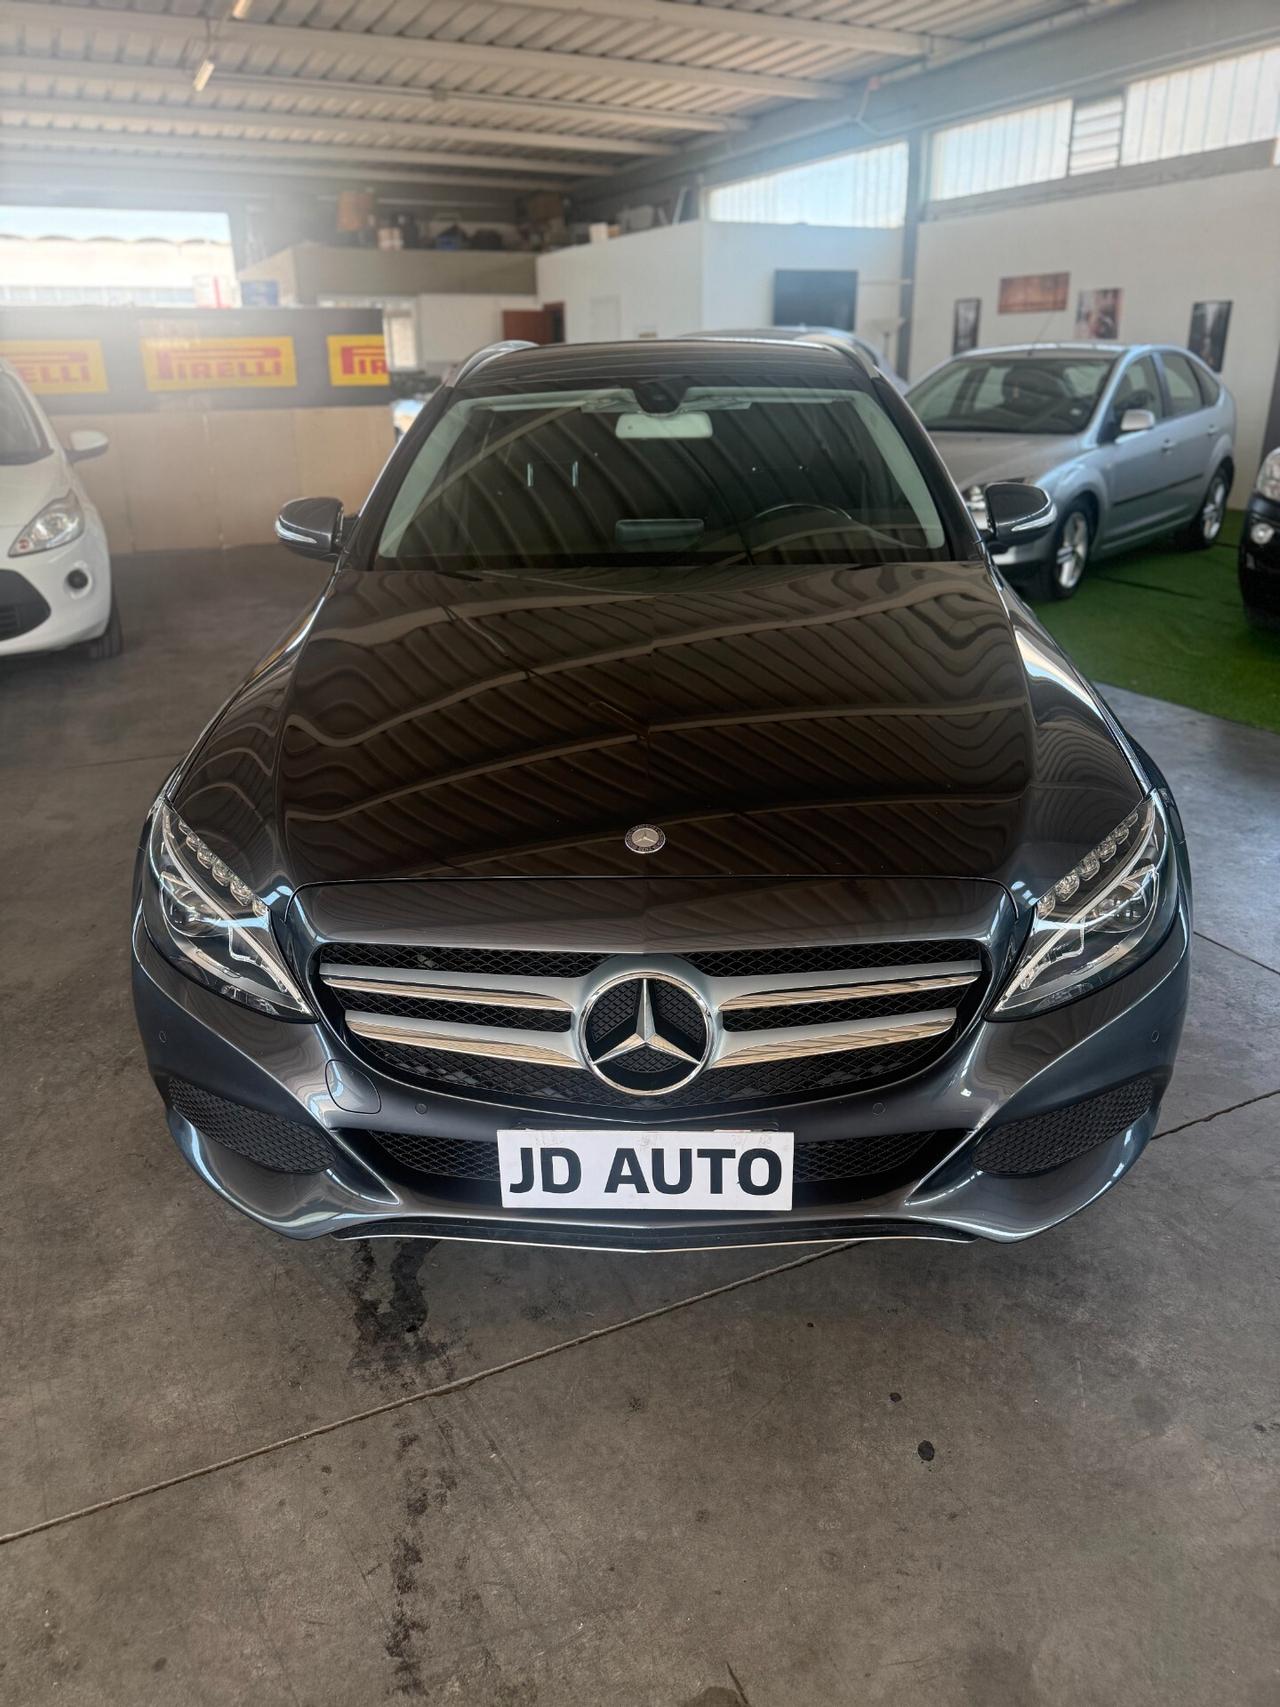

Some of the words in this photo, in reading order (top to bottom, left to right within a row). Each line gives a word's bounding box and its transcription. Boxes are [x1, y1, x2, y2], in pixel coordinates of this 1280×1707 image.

[156, 346, 283, 381] PIRELLI
[509, 1147, 582, 1194] JD
[604, 1147, 782, 1196] AUTO
